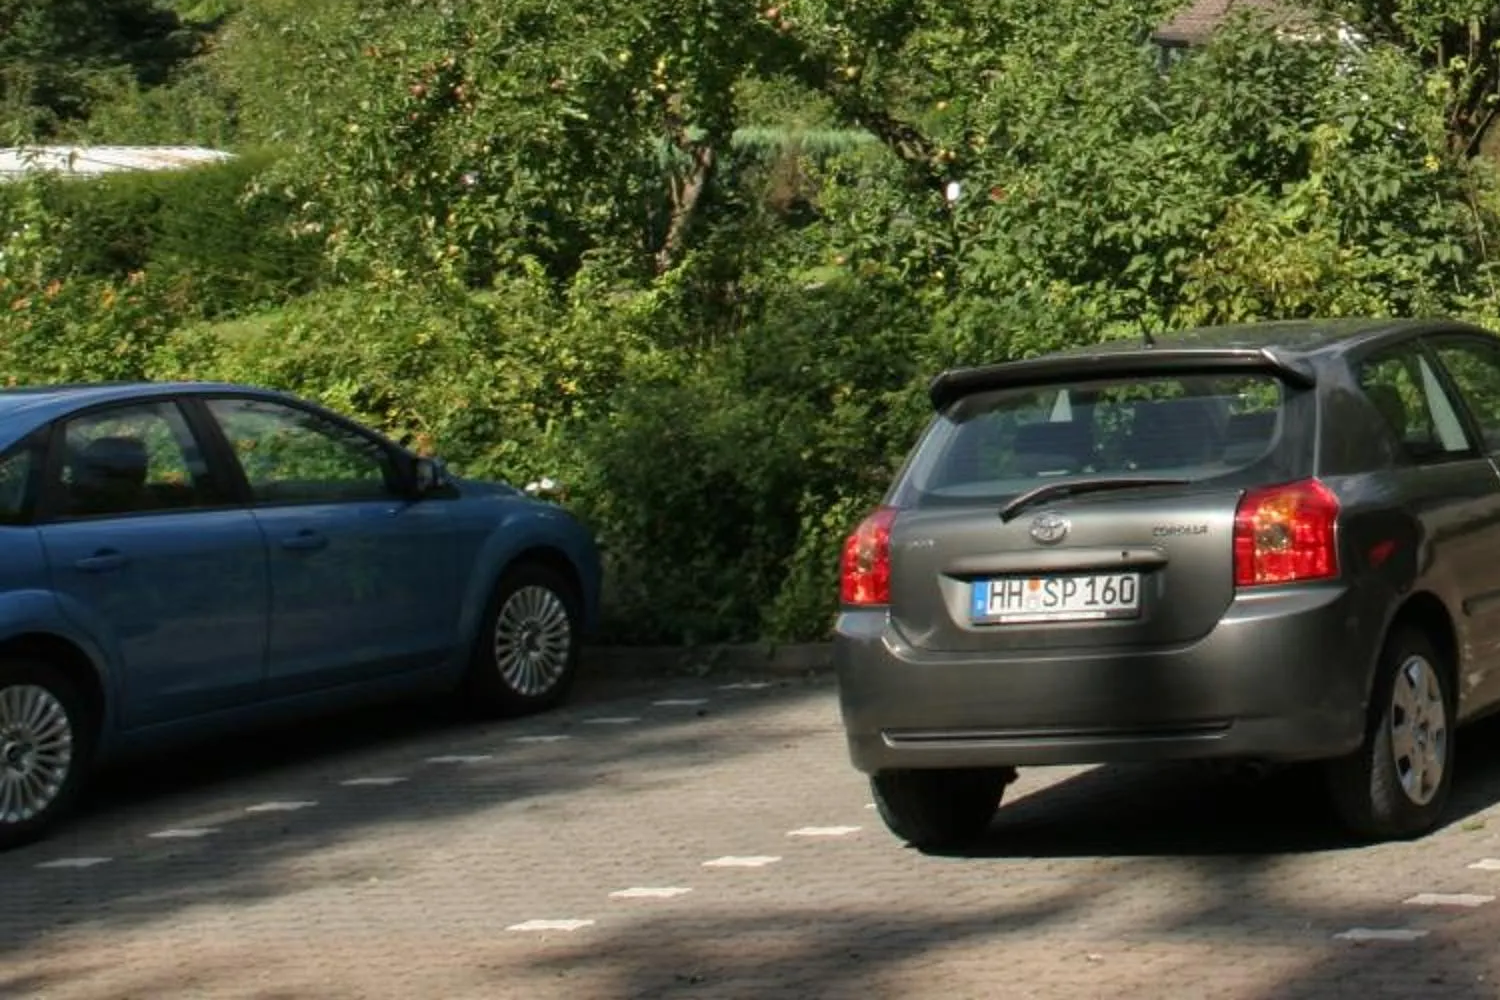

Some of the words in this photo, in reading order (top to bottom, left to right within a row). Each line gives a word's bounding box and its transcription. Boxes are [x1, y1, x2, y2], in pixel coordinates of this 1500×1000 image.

[989, 579, 1024, 609] HH
[1042, 578, 1077, 607] SP
[1084, 575, 1135, 605] 160
